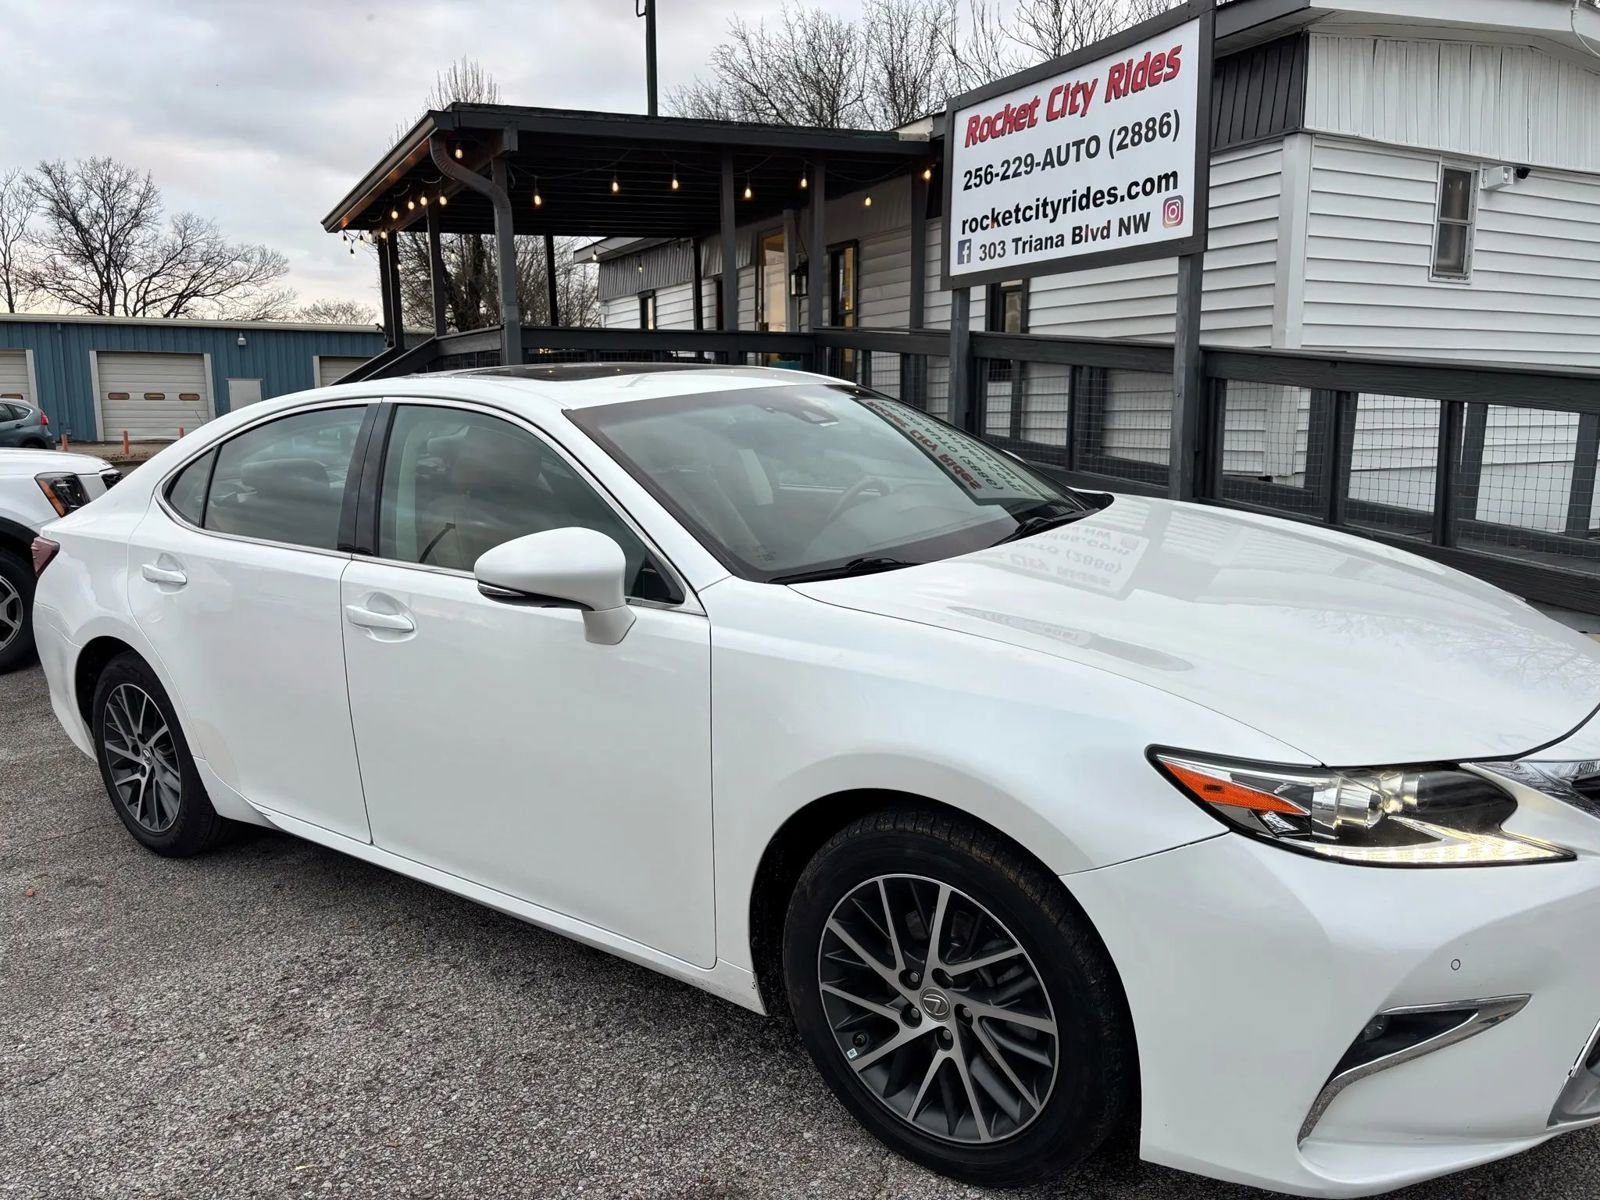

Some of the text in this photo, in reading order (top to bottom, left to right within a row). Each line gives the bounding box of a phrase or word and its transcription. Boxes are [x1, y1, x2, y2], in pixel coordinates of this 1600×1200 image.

[965, 45, 1183, 148] Rocket City Rides
[963, 109, 1180, 191] 256-229-AUTO (2886)
[961, 170, 1178, 235] rocketcityrides.com
[979, 240, 1006, 262] 303
[1012, 234, 1065, 255] Triana
[1071, 219, 1111, 245] Blvd
[1118, 211, 1151, 237] NW
